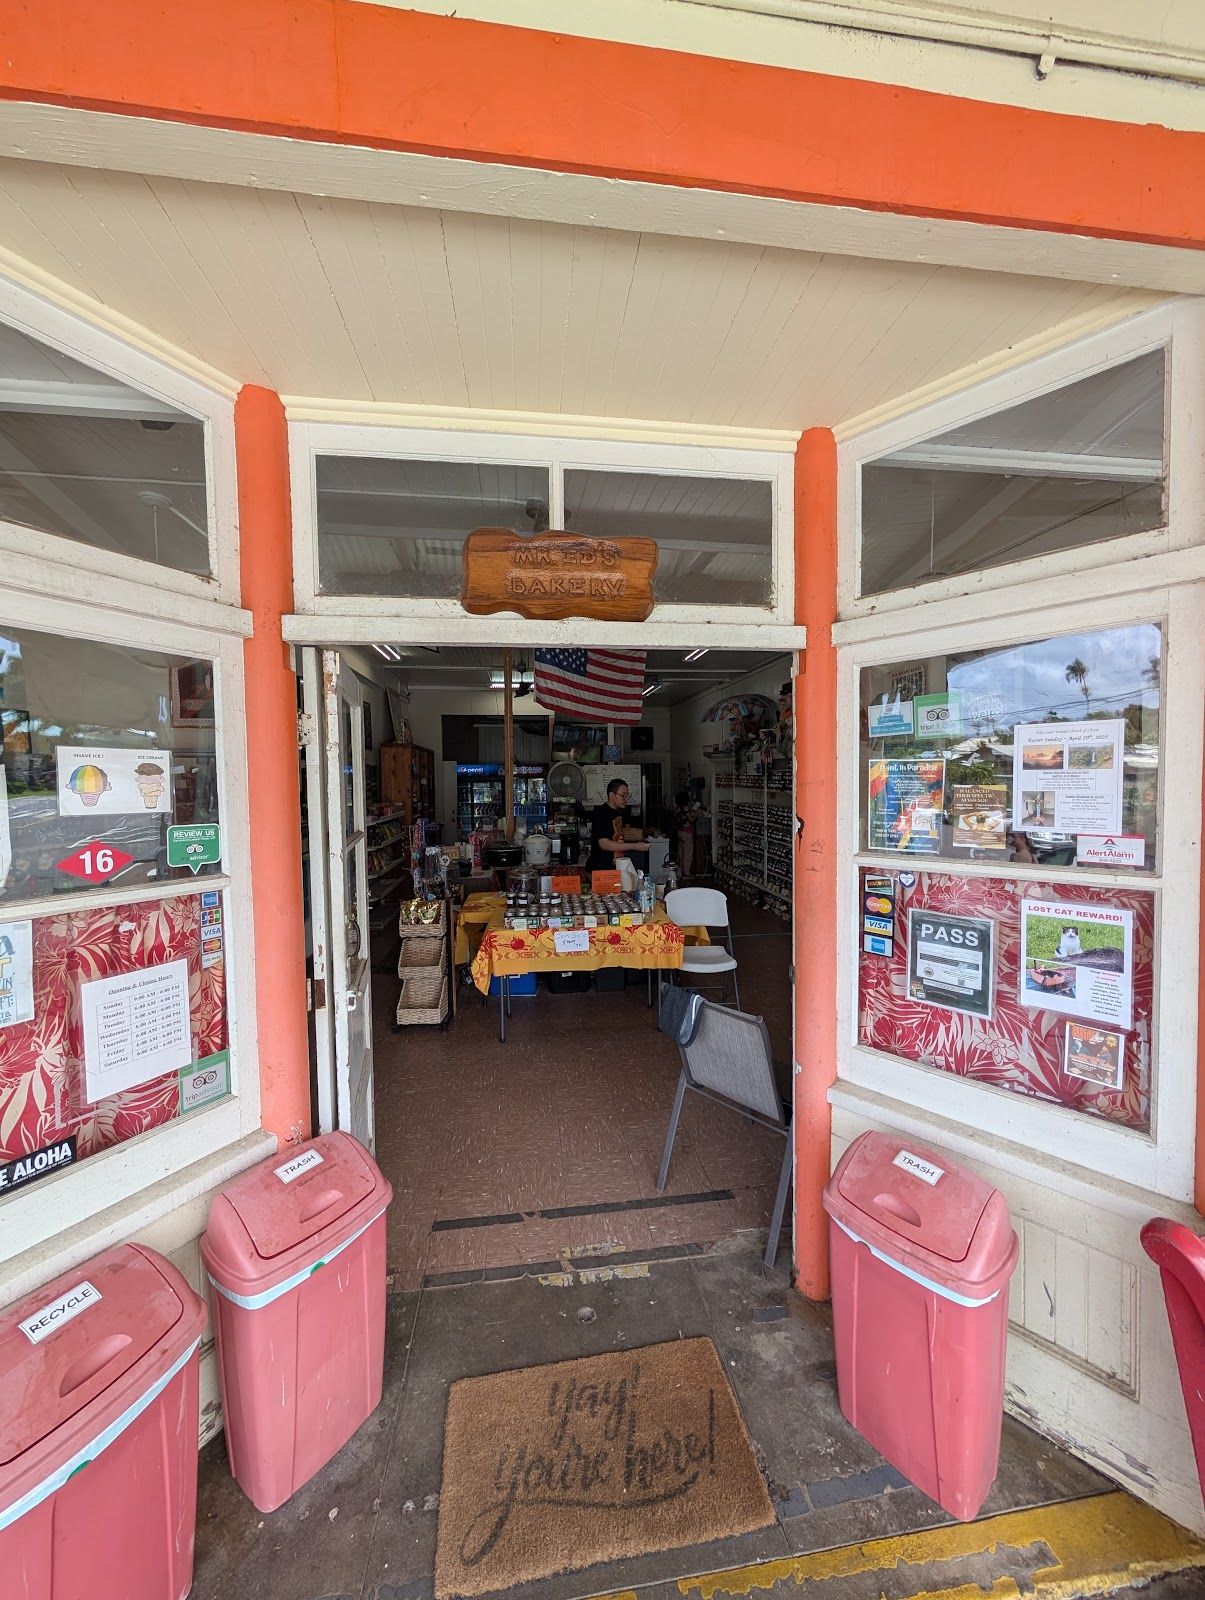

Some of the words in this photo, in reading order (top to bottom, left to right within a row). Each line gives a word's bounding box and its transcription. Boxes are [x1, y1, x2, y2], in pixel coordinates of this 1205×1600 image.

[513, 545, 557, 566] MR.
[562, 541, 618, 567] ED'S
[511, 577, 623, 596] BAKERY
[907, 764, 937, 772] Paradise
[80, 849, 114, 874] 16
[1028, 905, 1052, 913] LOST
[1076, 910, 1123, 922] REWARD!
[204, 927, 221, 936] VISA
[869, 920, 888, 930] VISA
[921, 923, 979, 947] PASS
[108, 985, 131, 996] Opening
[138, 978, 158, 988] Closing
[103, 1001, 124, 1010] Sunday
[103, 1010, 124, 1020] Monday
[104, 1020, 125, 1029] Tuesday
[100, 1028, 130, 1040] Wednesday
[103, 1038, 128, 1049] Thursday
[107, 1048, 125, 1057] Friday
[104, 1056, 128, 1068] Saturday
[13, 1142, 72, 1181] ALOHA
[282, 1154, 316, 1176] TRASH
[902, 1156, 935, 1177] TRASH
[28, 1288, 94, 1334] RECYCLE
[623, 1389, 717, 1491] here!
